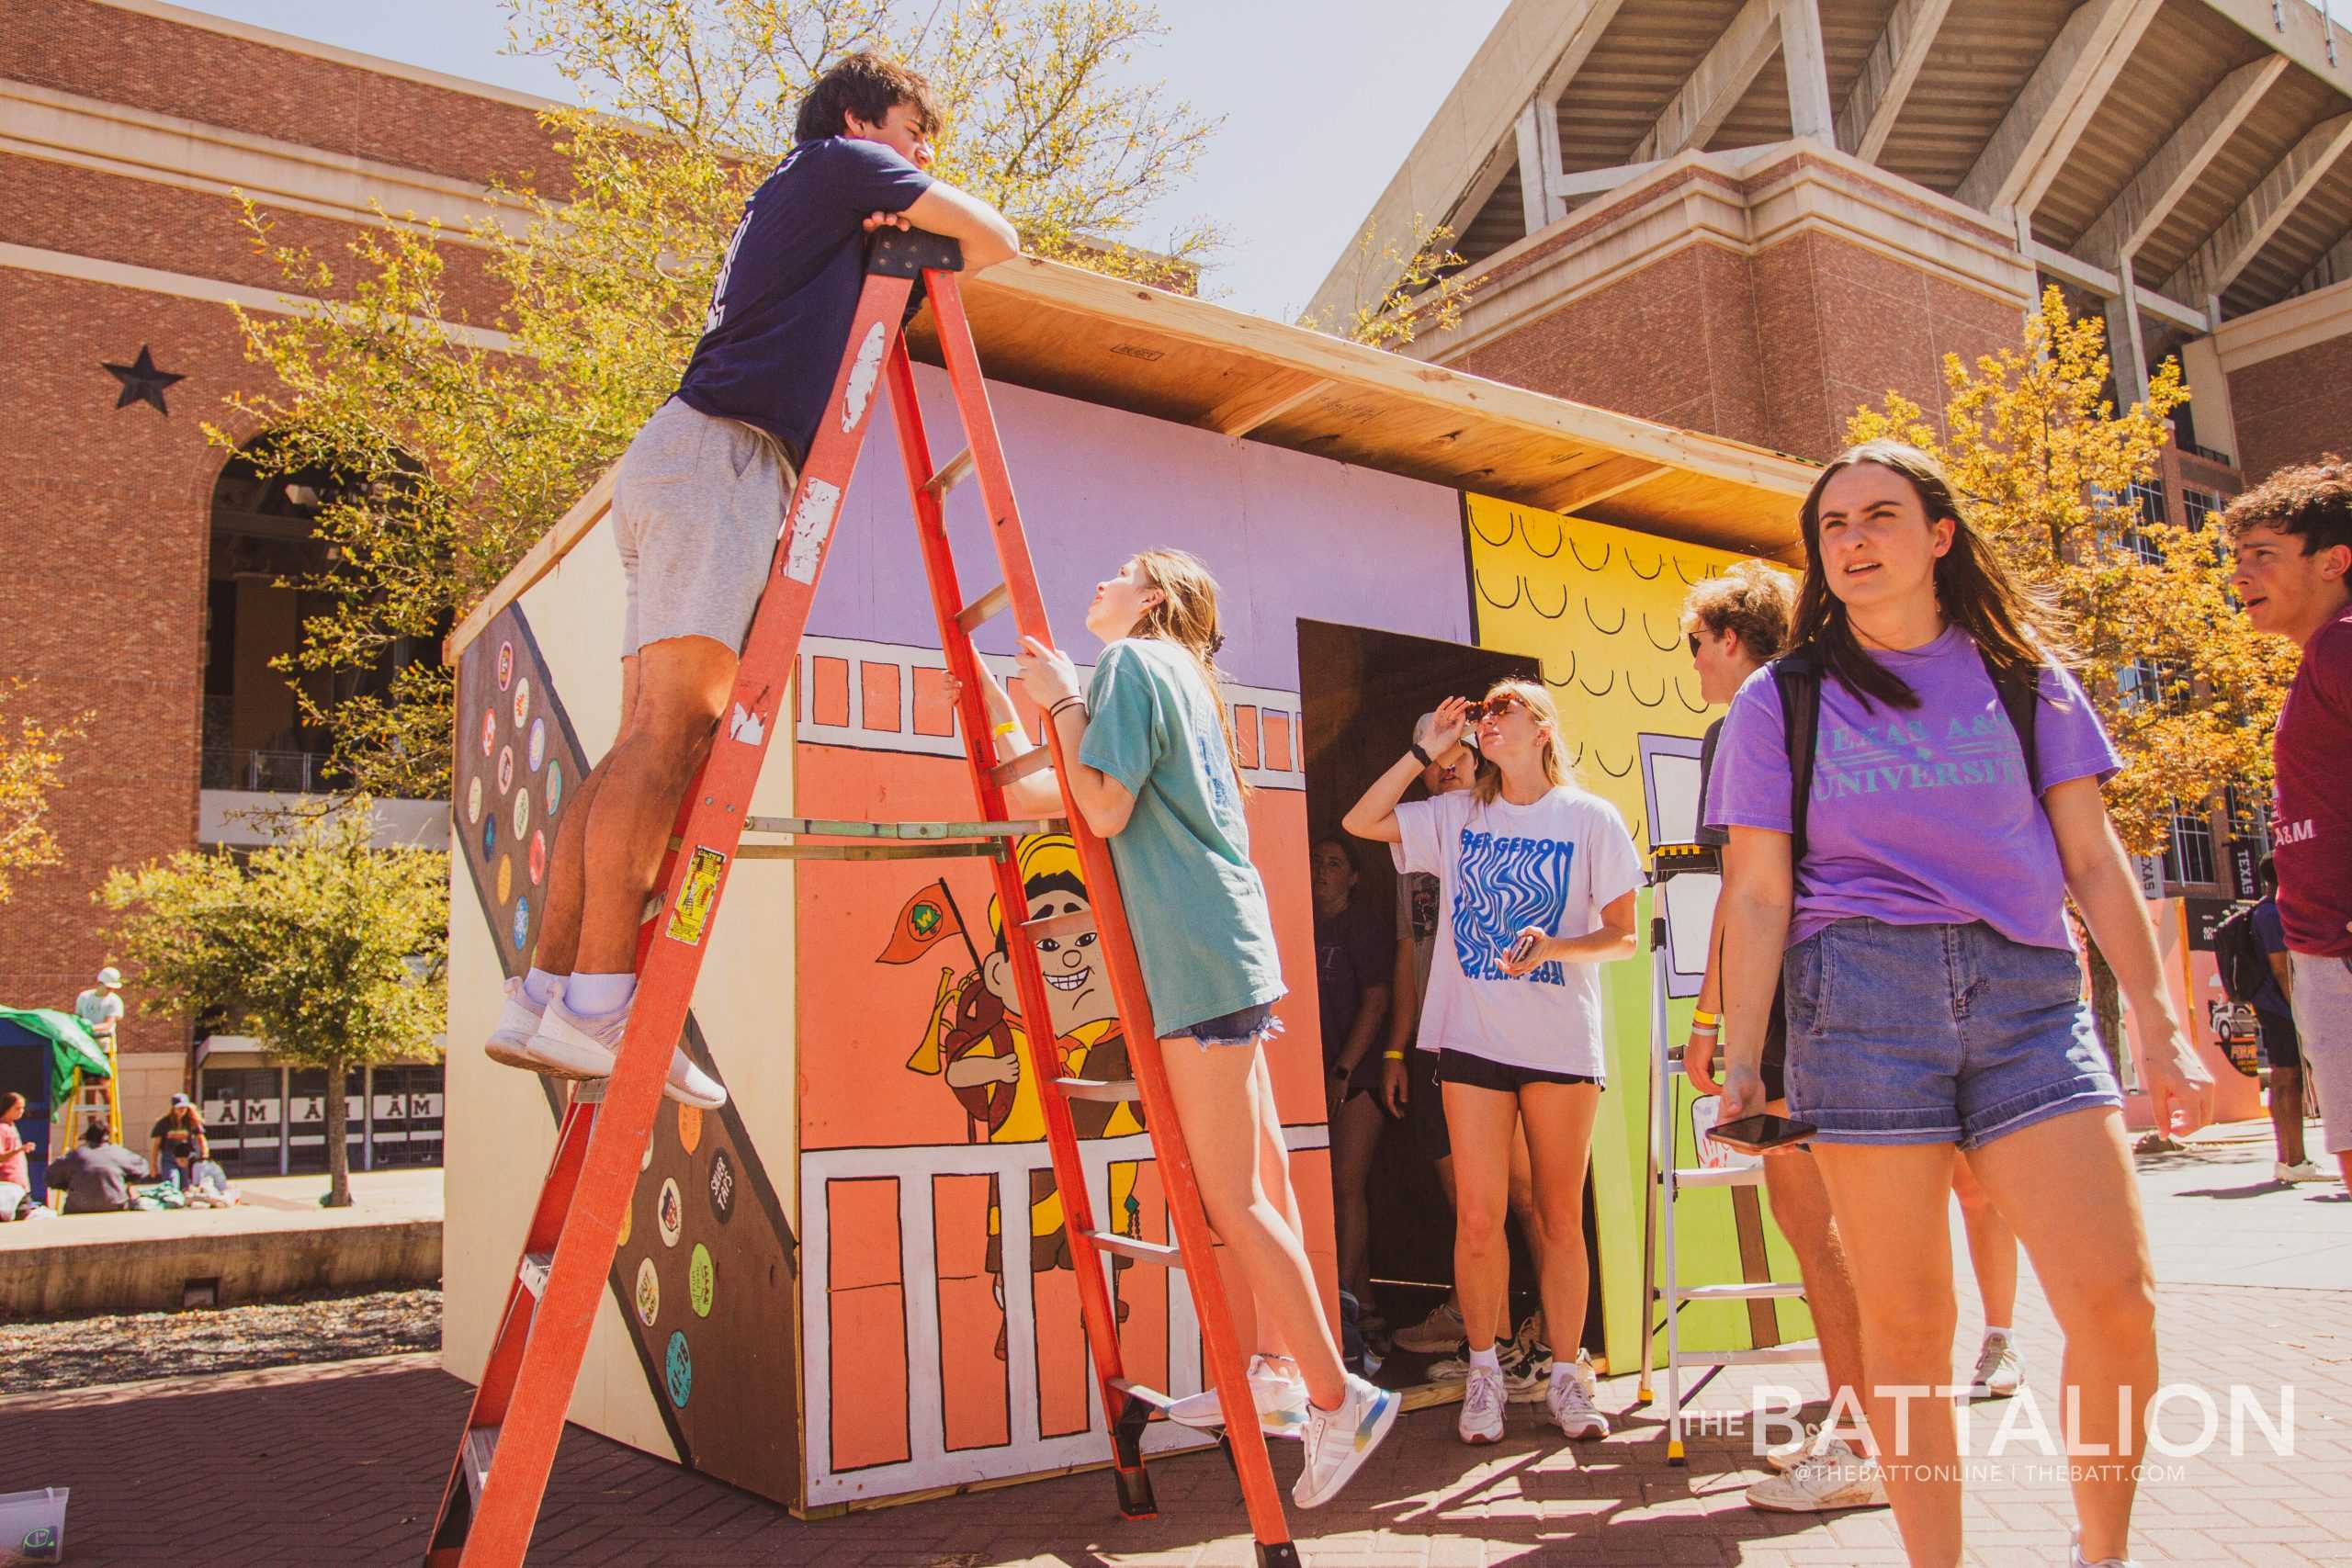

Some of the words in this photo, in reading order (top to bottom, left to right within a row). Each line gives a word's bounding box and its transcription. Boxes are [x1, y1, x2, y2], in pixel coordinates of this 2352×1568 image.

[1813, 757, 2029, 801] UNIVERSIT
[1461, 829, 1575, 858] BERGERON
[2275, 818, 2313, 847] A&M
[2141, 855, 2155, 890] XAS
[2237, 849, 2255, 896] TEXAS
